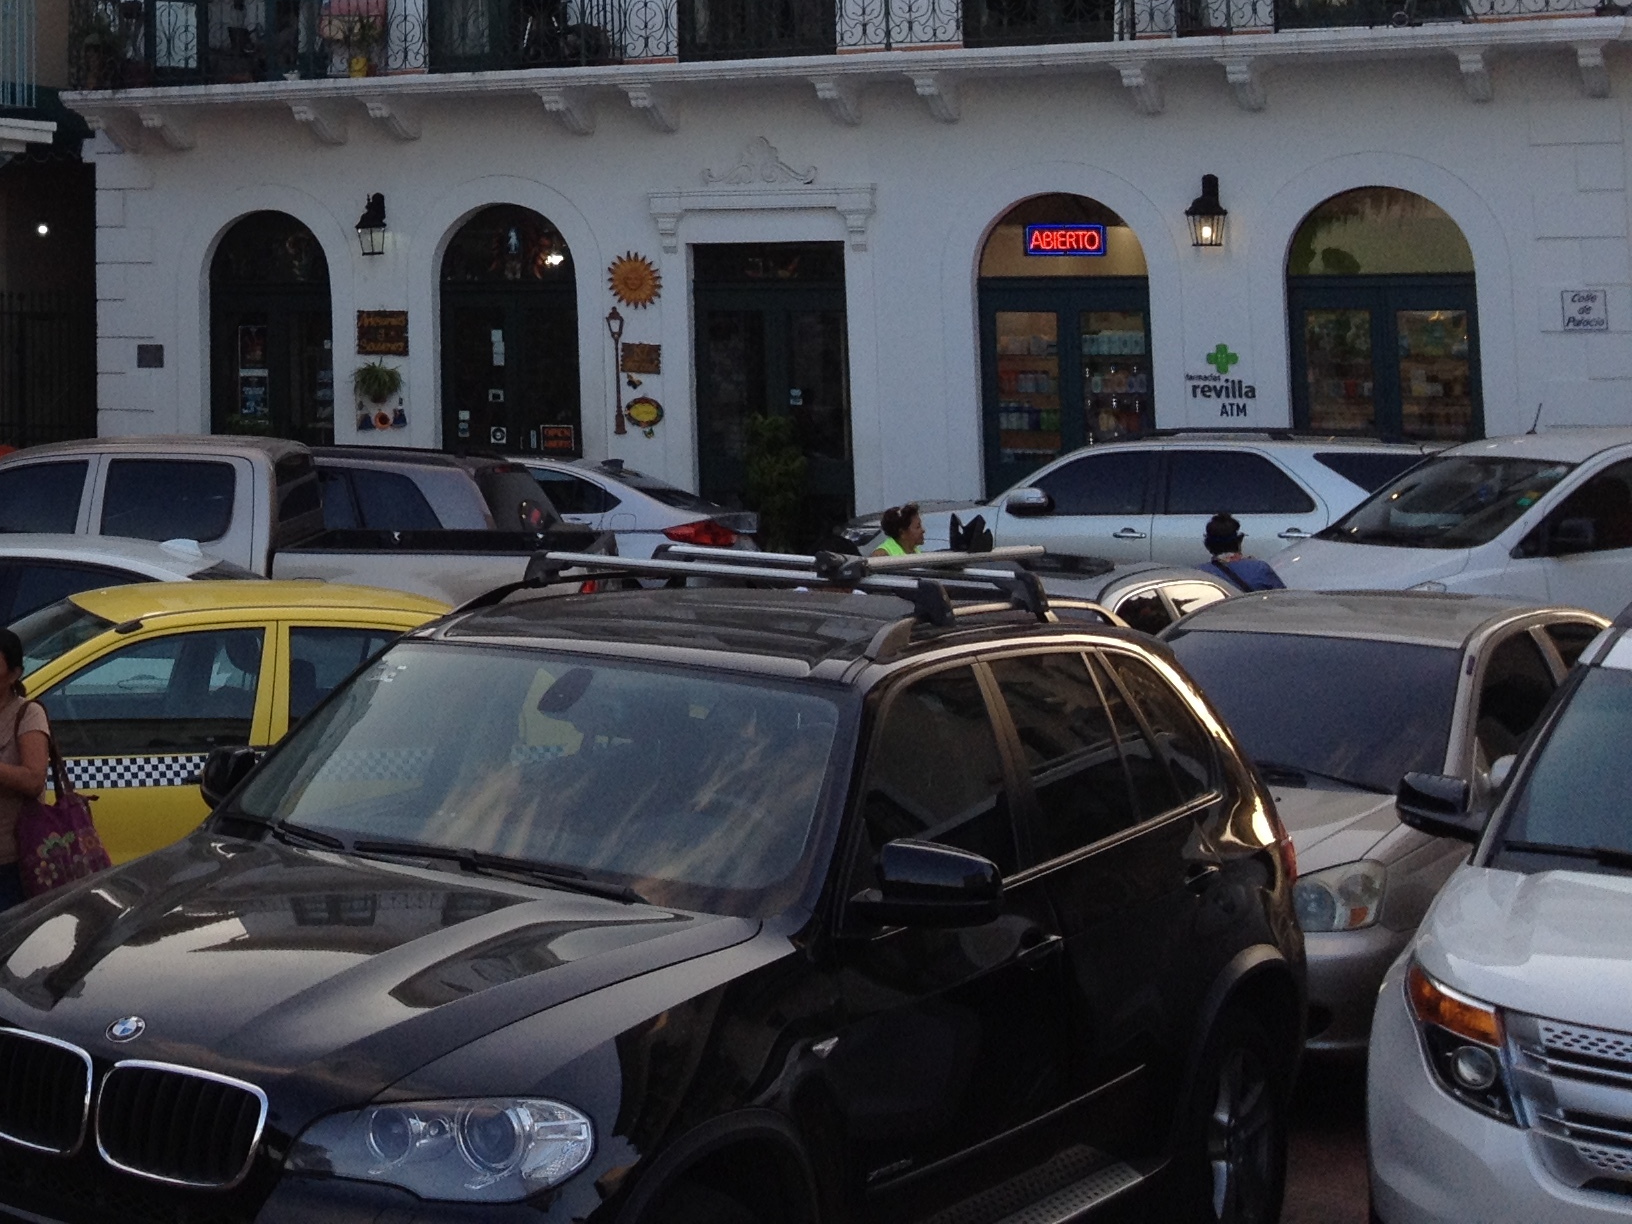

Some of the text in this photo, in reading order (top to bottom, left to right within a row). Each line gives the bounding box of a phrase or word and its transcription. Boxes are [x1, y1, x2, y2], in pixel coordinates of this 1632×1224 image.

[1030, 230, 1099, 250] ABIERTO
[1571, 293, 1597, 303] Calle
[1577, 305, 1592, 315] de
[1192, 378, 1256, 399] revilla
[1220, 403, 1247, 417] ATM
